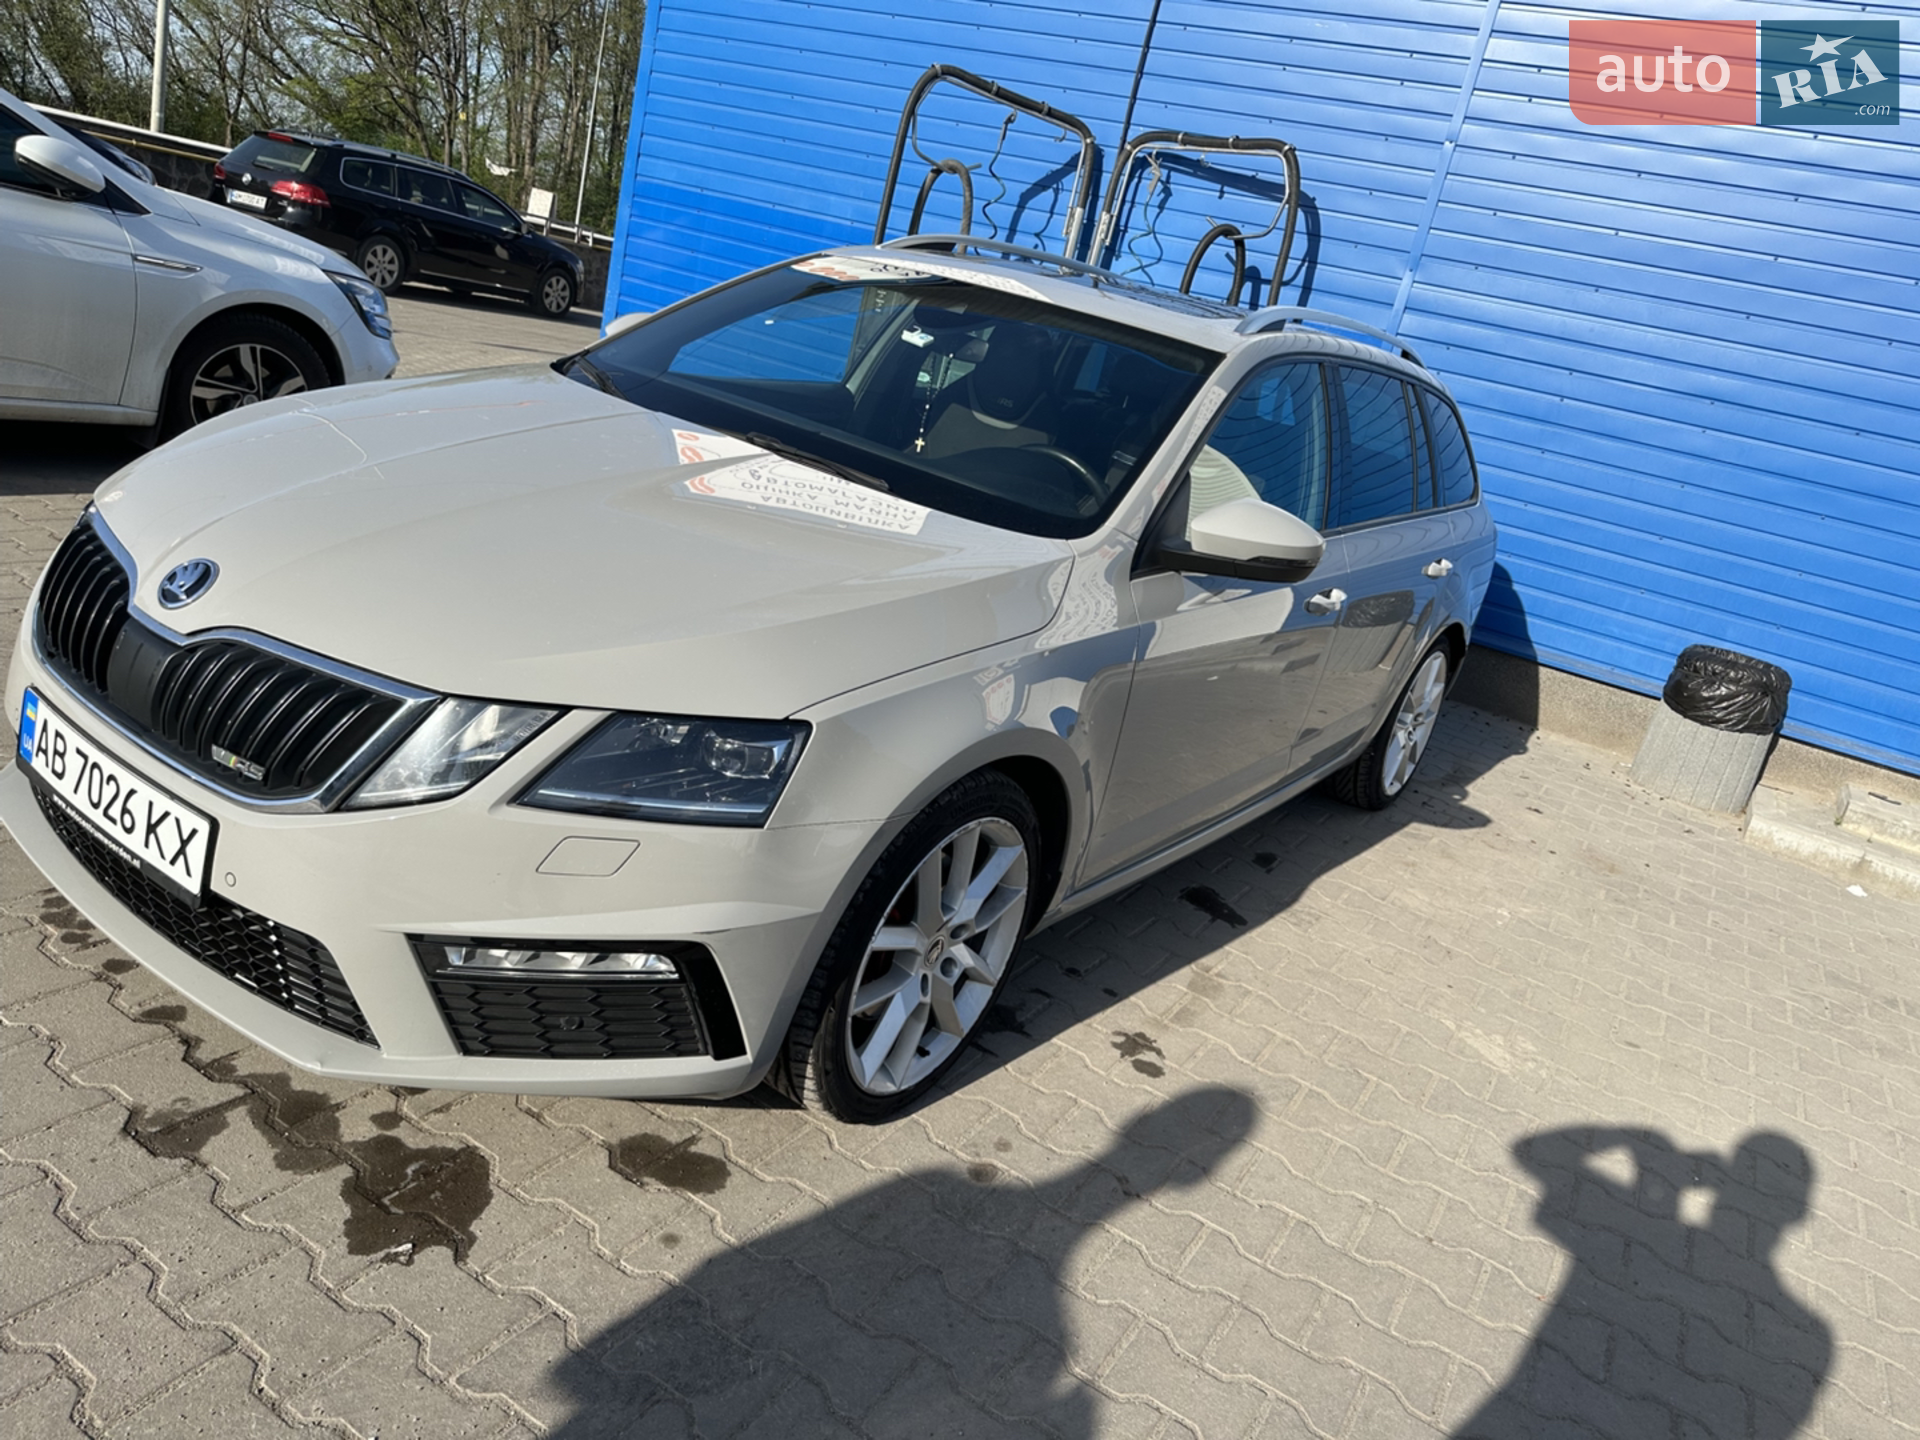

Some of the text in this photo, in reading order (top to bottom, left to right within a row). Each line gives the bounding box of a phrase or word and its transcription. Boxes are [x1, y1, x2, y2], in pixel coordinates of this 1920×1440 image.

[35, 717, 199, 878] AB 7026 KX
